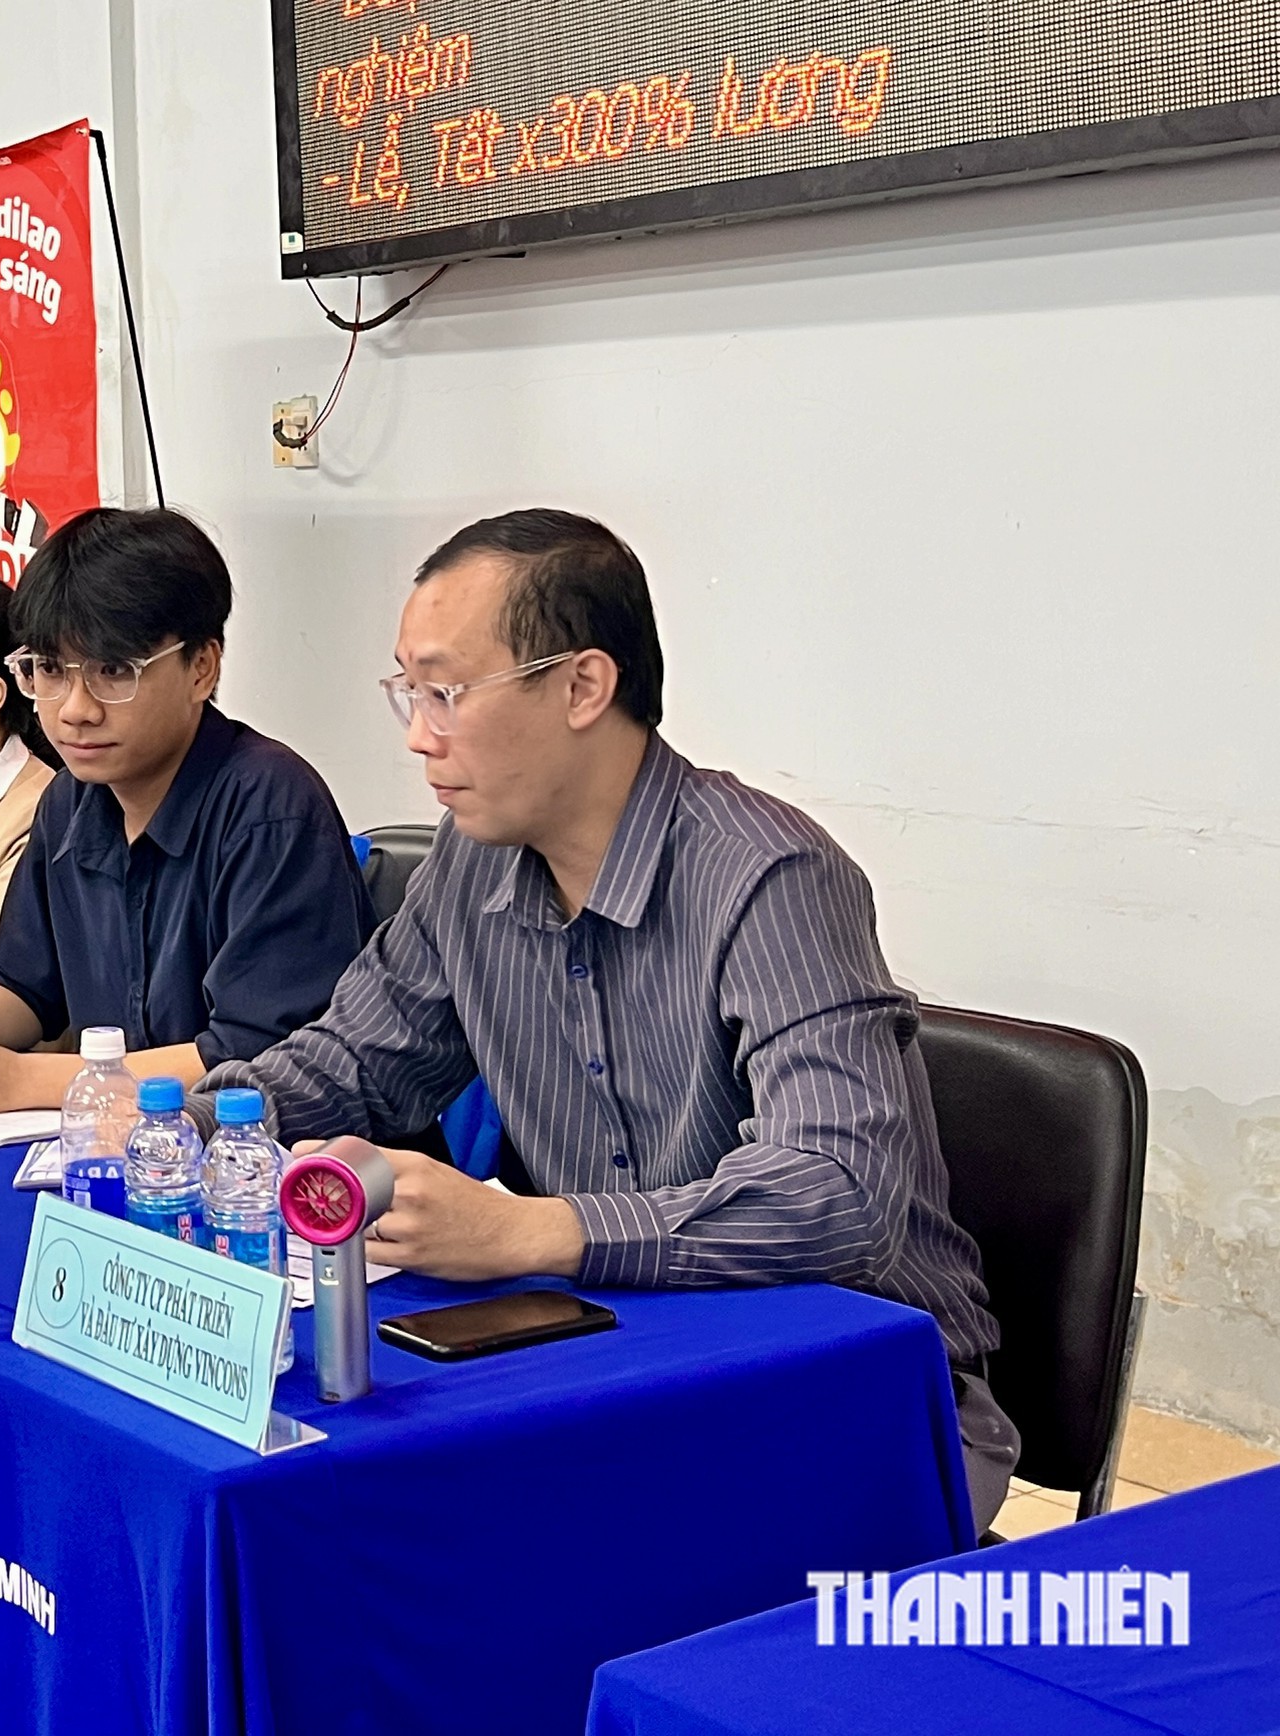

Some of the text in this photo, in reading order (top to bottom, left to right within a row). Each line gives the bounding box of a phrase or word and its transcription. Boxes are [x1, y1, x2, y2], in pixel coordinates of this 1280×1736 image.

[314, 23, 470, 127] nghiệm
[433, 107, 505, 188] Tết
[510, 71, 696, 173] x300%
[713, 47, 891, 137] lương
[52, 1266, 66, 1302] 8
[102, 1252, 235, 1340] CÔNG TY CP PHÁT TRIỂN
[80, 1294, 248, 1402] VÀ ĐẦU TƯ XÂY DỰNG VINCONS
